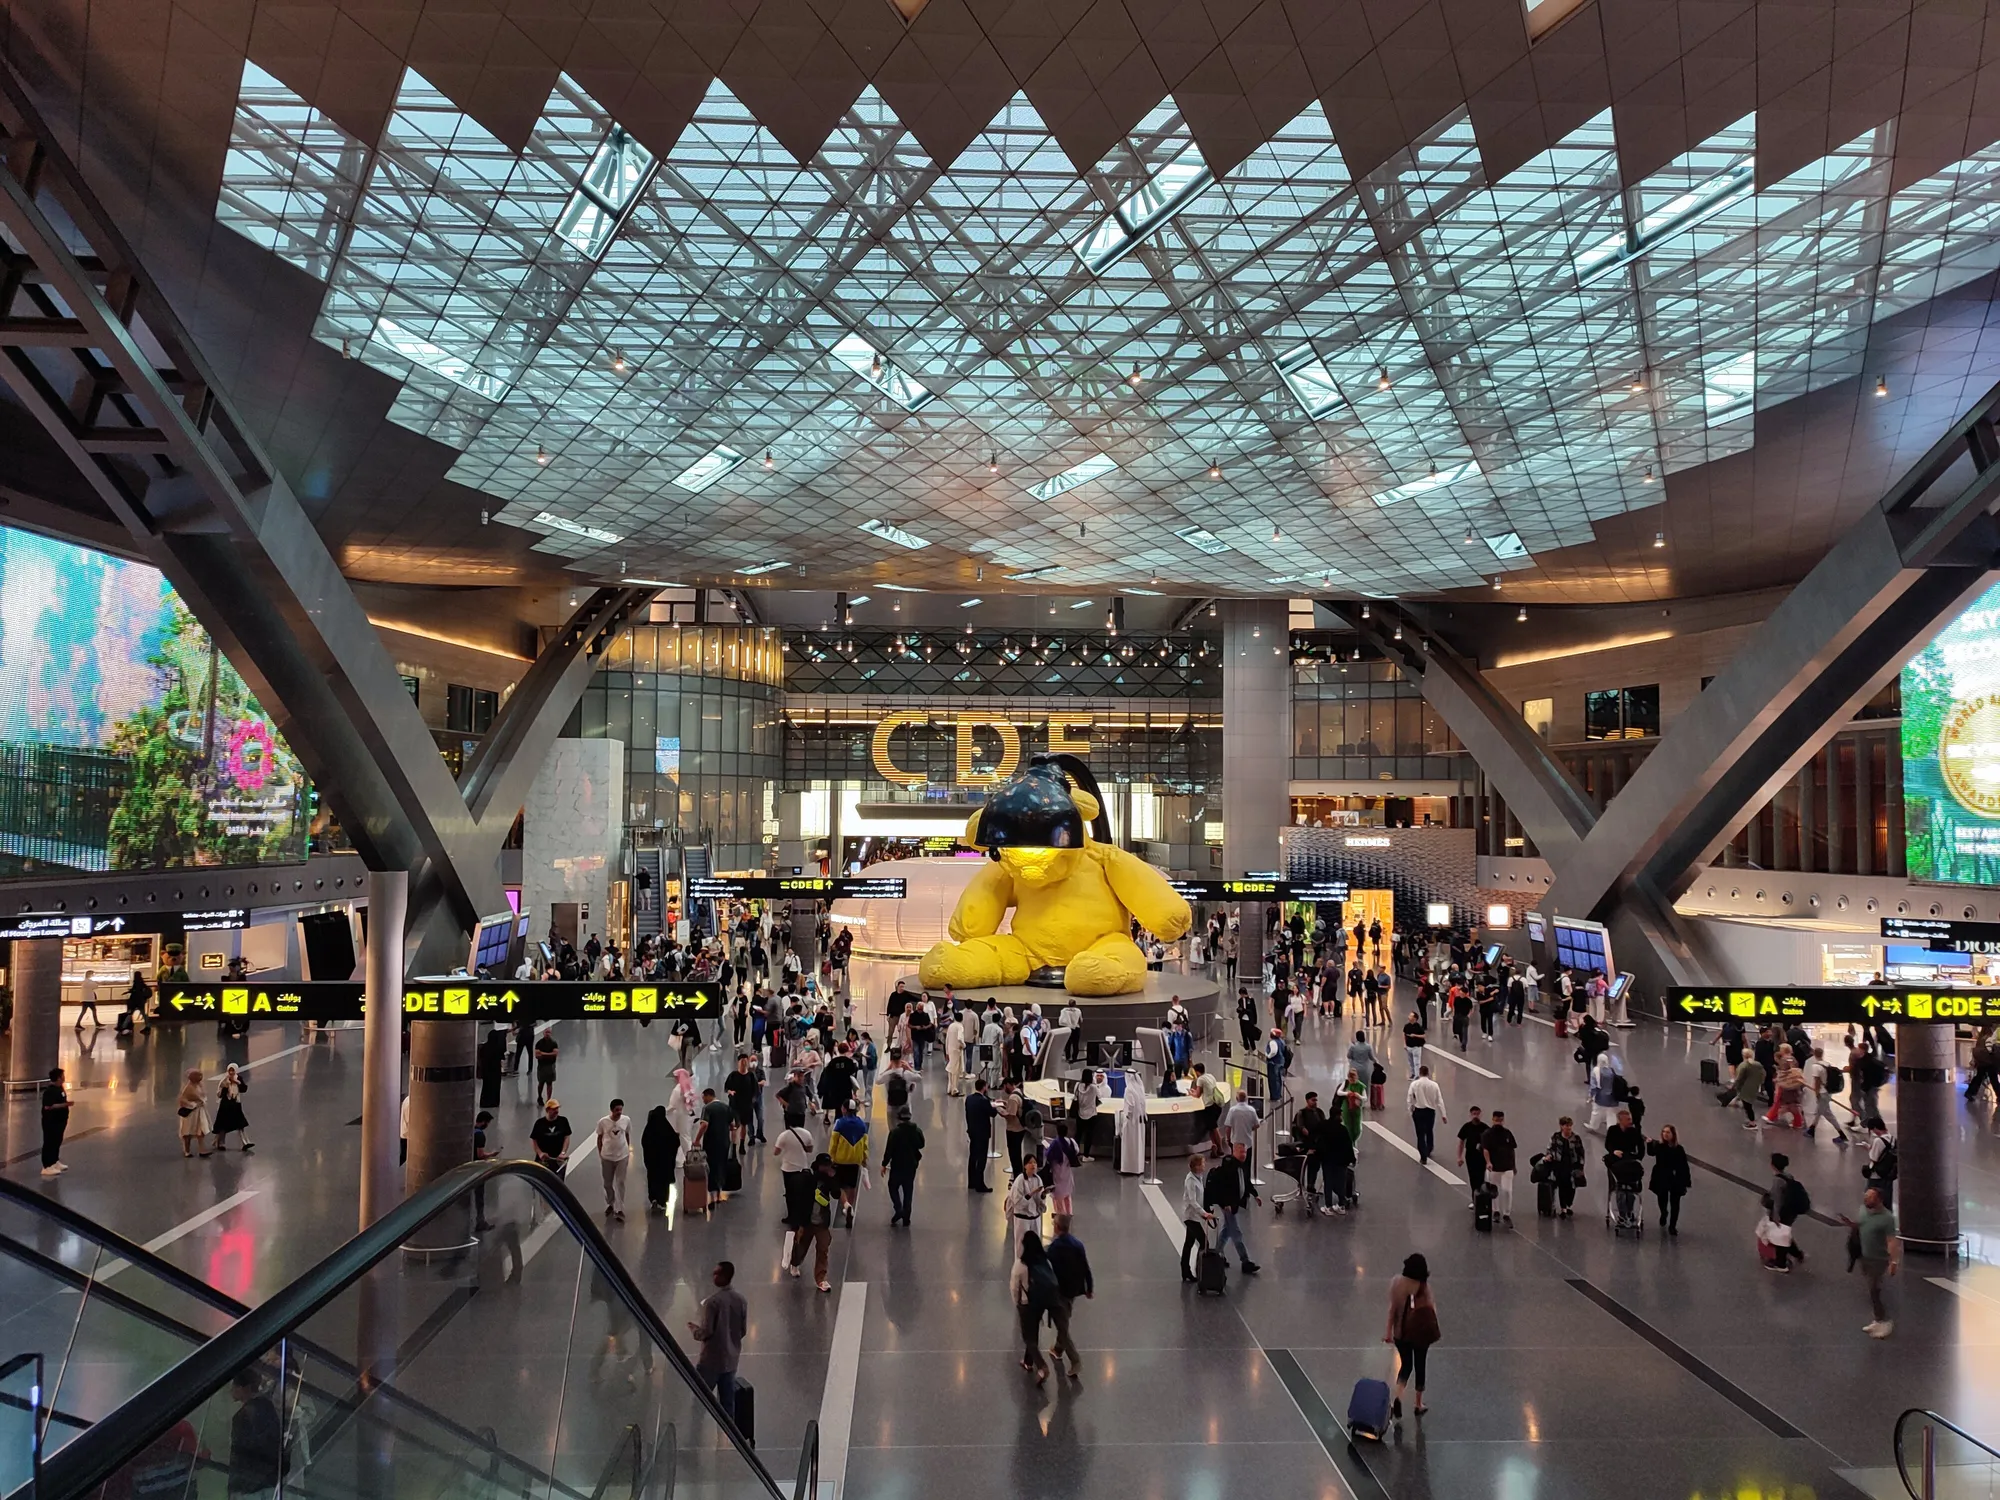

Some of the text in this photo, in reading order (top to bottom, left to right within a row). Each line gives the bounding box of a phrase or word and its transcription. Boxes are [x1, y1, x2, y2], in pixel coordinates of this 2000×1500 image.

[1951, 698, 1985, 739] WORLD
[790, 881, 812, 889] CDE
[1244, 883, 1265, 892] CDE
[41, 928, 70, 937] Lounge
[1955, 940, 2000, 953] DIOR
[252, 992, 272, 1012] A
[276, 1004, 299, 1012] Gates
[402, 993, 439, 1012] DE
[610, 992, 627, 1011] B
[1760, 996, 1779, 1015] A
[1935, 997, 1983, 1016] CDE
